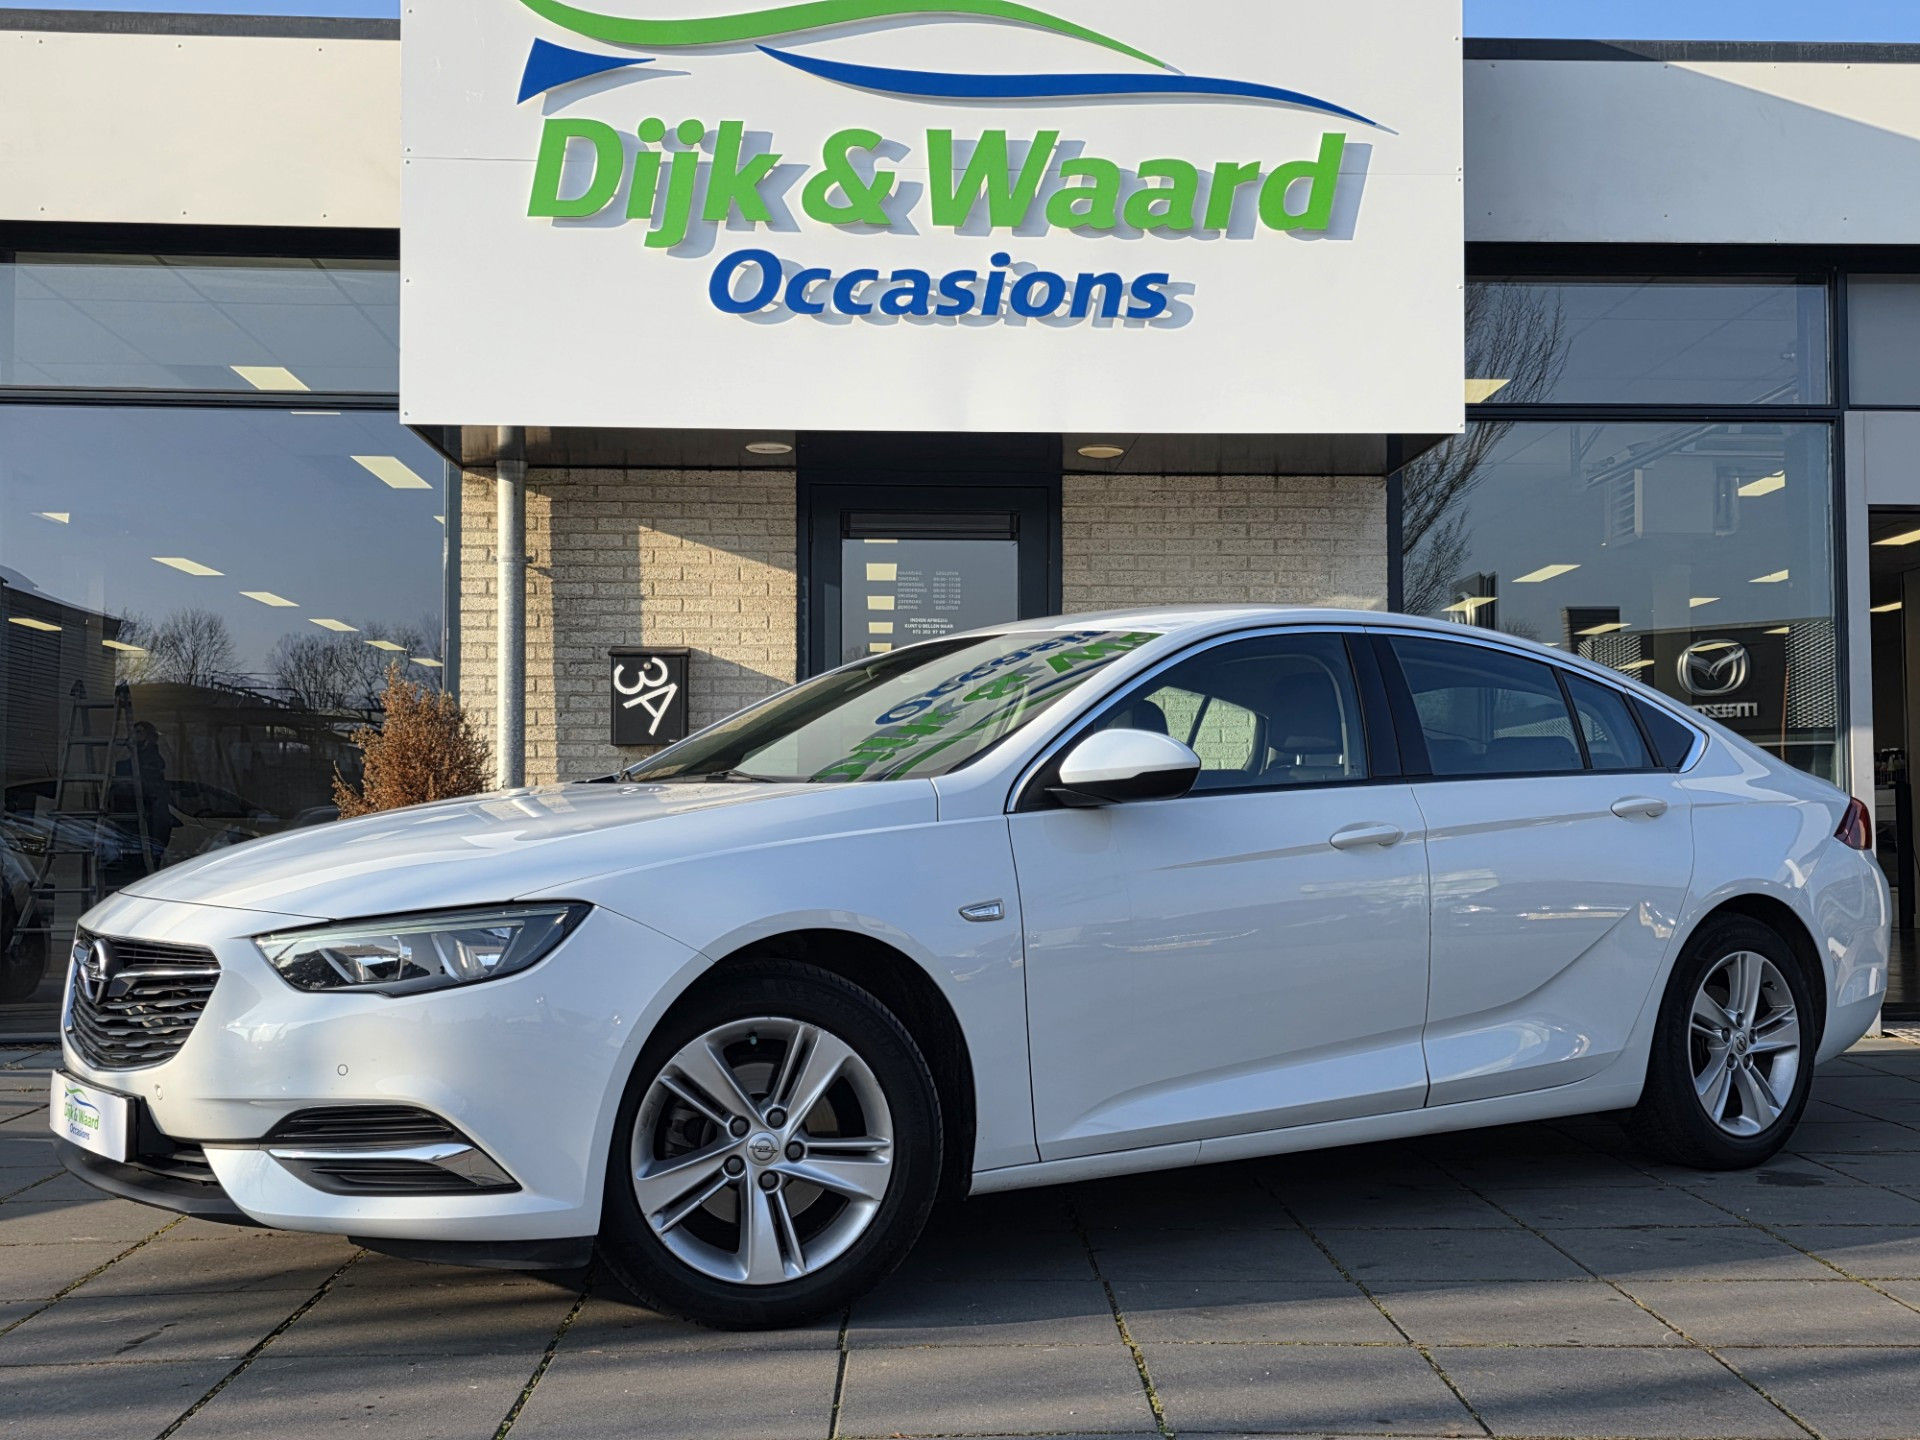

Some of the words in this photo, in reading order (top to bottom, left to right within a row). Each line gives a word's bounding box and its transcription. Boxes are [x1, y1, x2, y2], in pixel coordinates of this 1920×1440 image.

[526, 116, 782, 249] Dijk
[801, 127, 896, 225] &
[925, 128, 1347, 232] Waard
[708, 248, 1169, 319] Occasions
[613, 656, 678, 737] 3A
[64, 1102, 73, 1122] Dijk
[78, 1109, 99, 1130] Waard
[70, 1123, 90, 1140] Occasions
